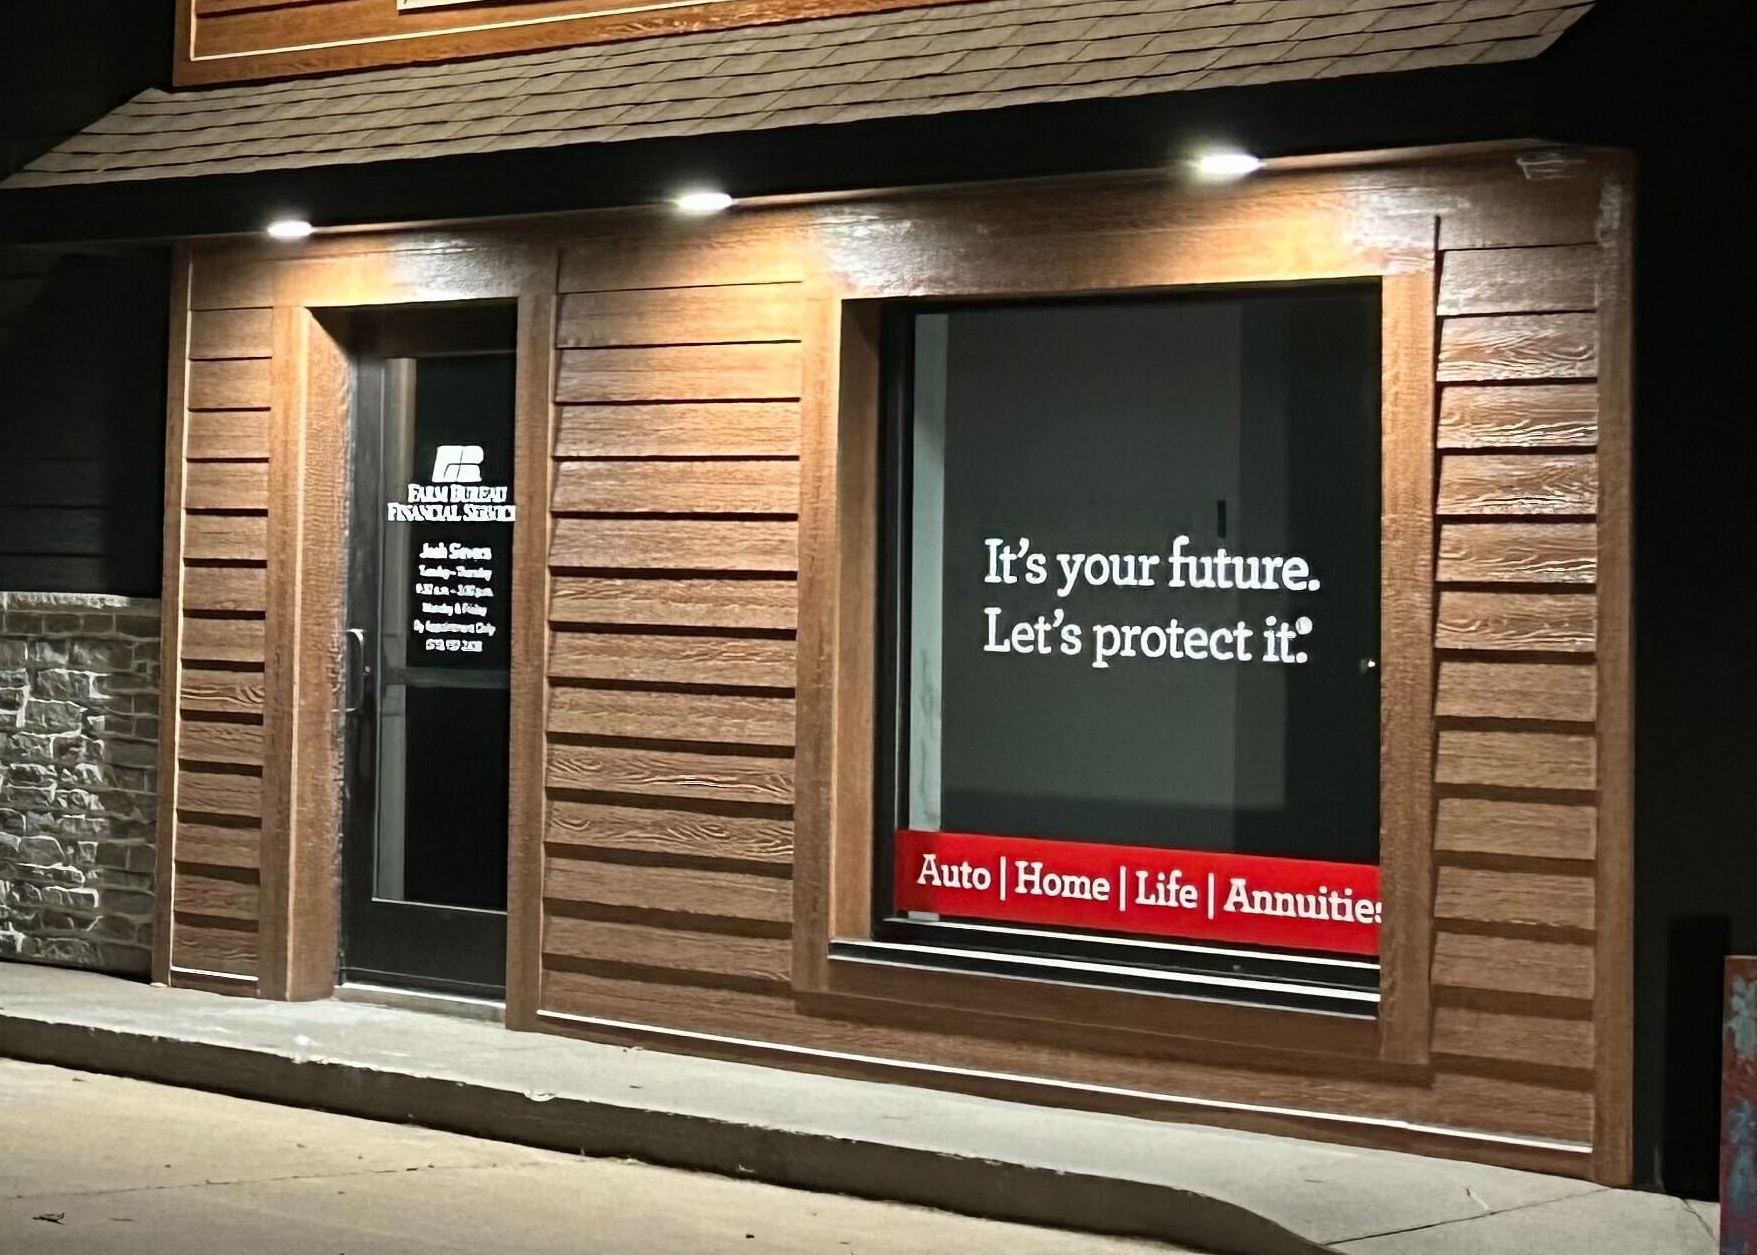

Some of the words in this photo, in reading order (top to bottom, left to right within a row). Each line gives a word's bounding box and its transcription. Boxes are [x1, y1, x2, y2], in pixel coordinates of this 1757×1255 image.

[387, 502, 462, 522] FINANCIAL
[407, 483, 449, 503] FARM
[449, 483, 508, 503] BUREAU
[983, 537, 1048, 585] It's
[1055, 551, 1160, 598] your
[1168, 535, 1321, 592] future.
[983, 606, 1083, 656] Let's
[1091, 618, 1254, 668] protect
[916, 853, 992, 891] Auto
[1014, 860, 1111, 902] Home
[1134, 869, 1199, 910] Life
